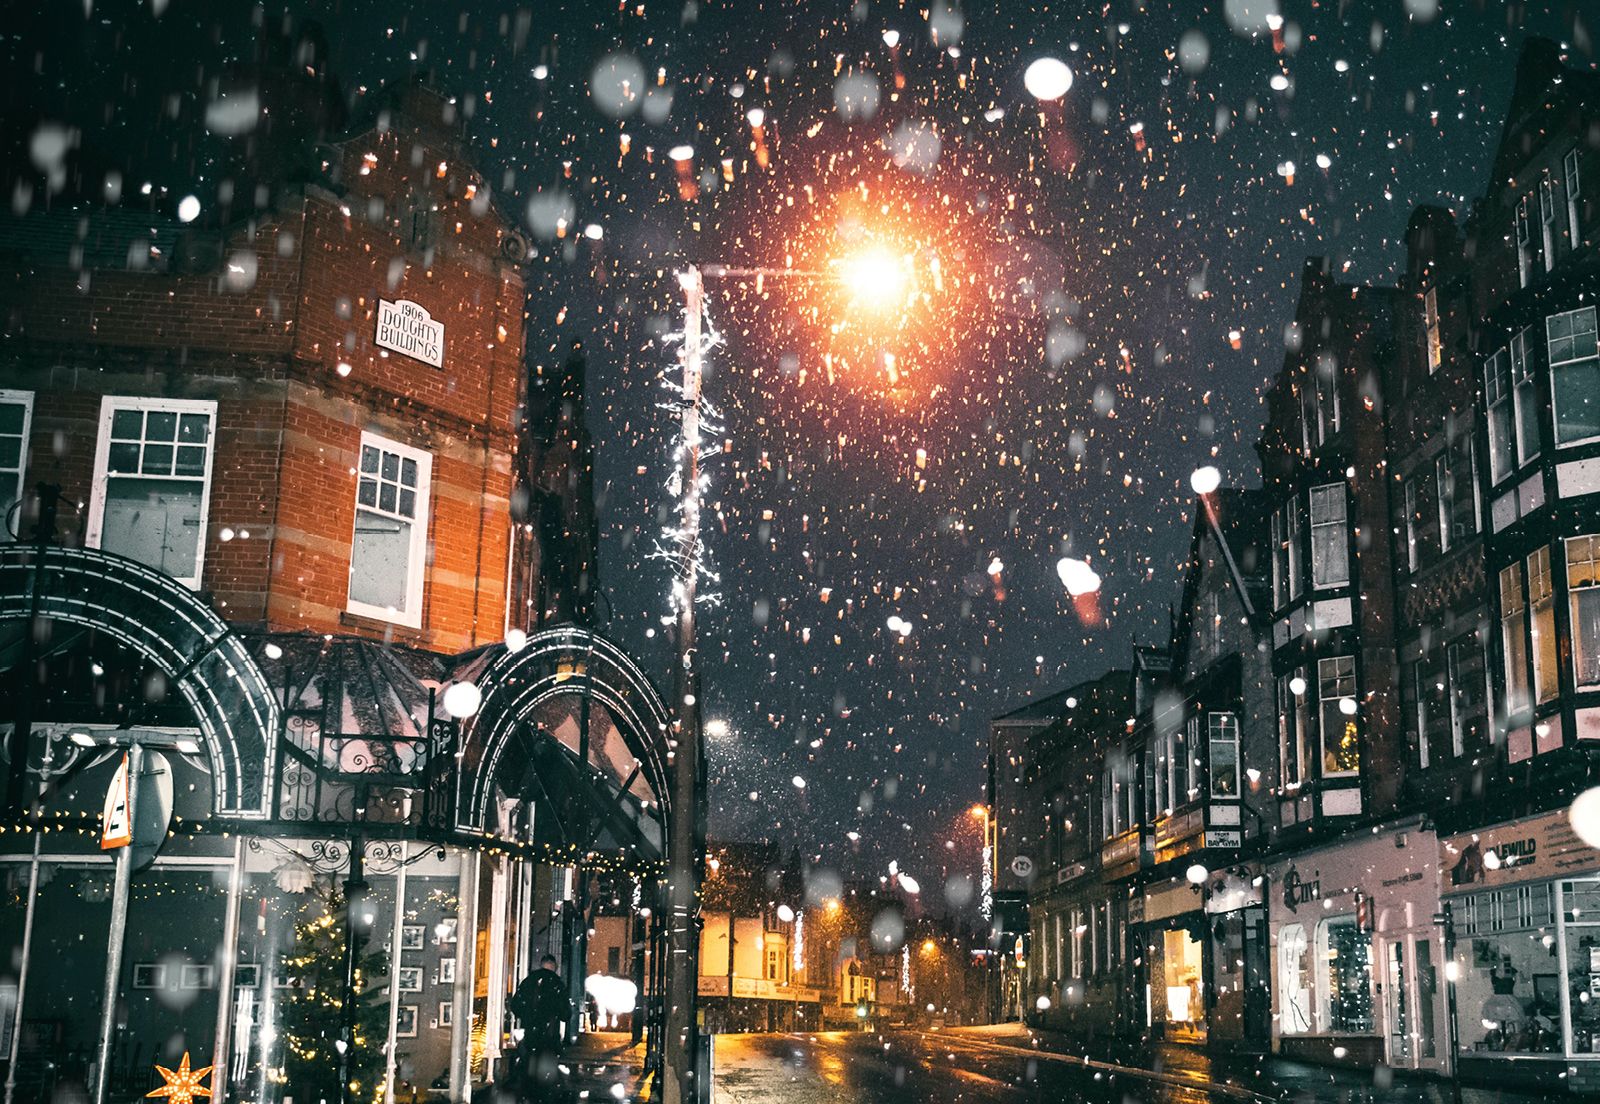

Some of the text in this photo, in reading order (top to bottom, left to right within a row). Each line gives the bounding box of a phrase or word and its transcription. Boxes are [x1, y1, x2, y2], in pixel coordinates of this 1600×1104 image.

[401, 304, 424, 322] 1906
[383, 309, 439, 344] DOUGHTY
[380, 325, 439, 361] BUILDINGS
[1207, 839, 1239, 847] BAY GYM
[1486, 838, 1536, 862] LEWILD
